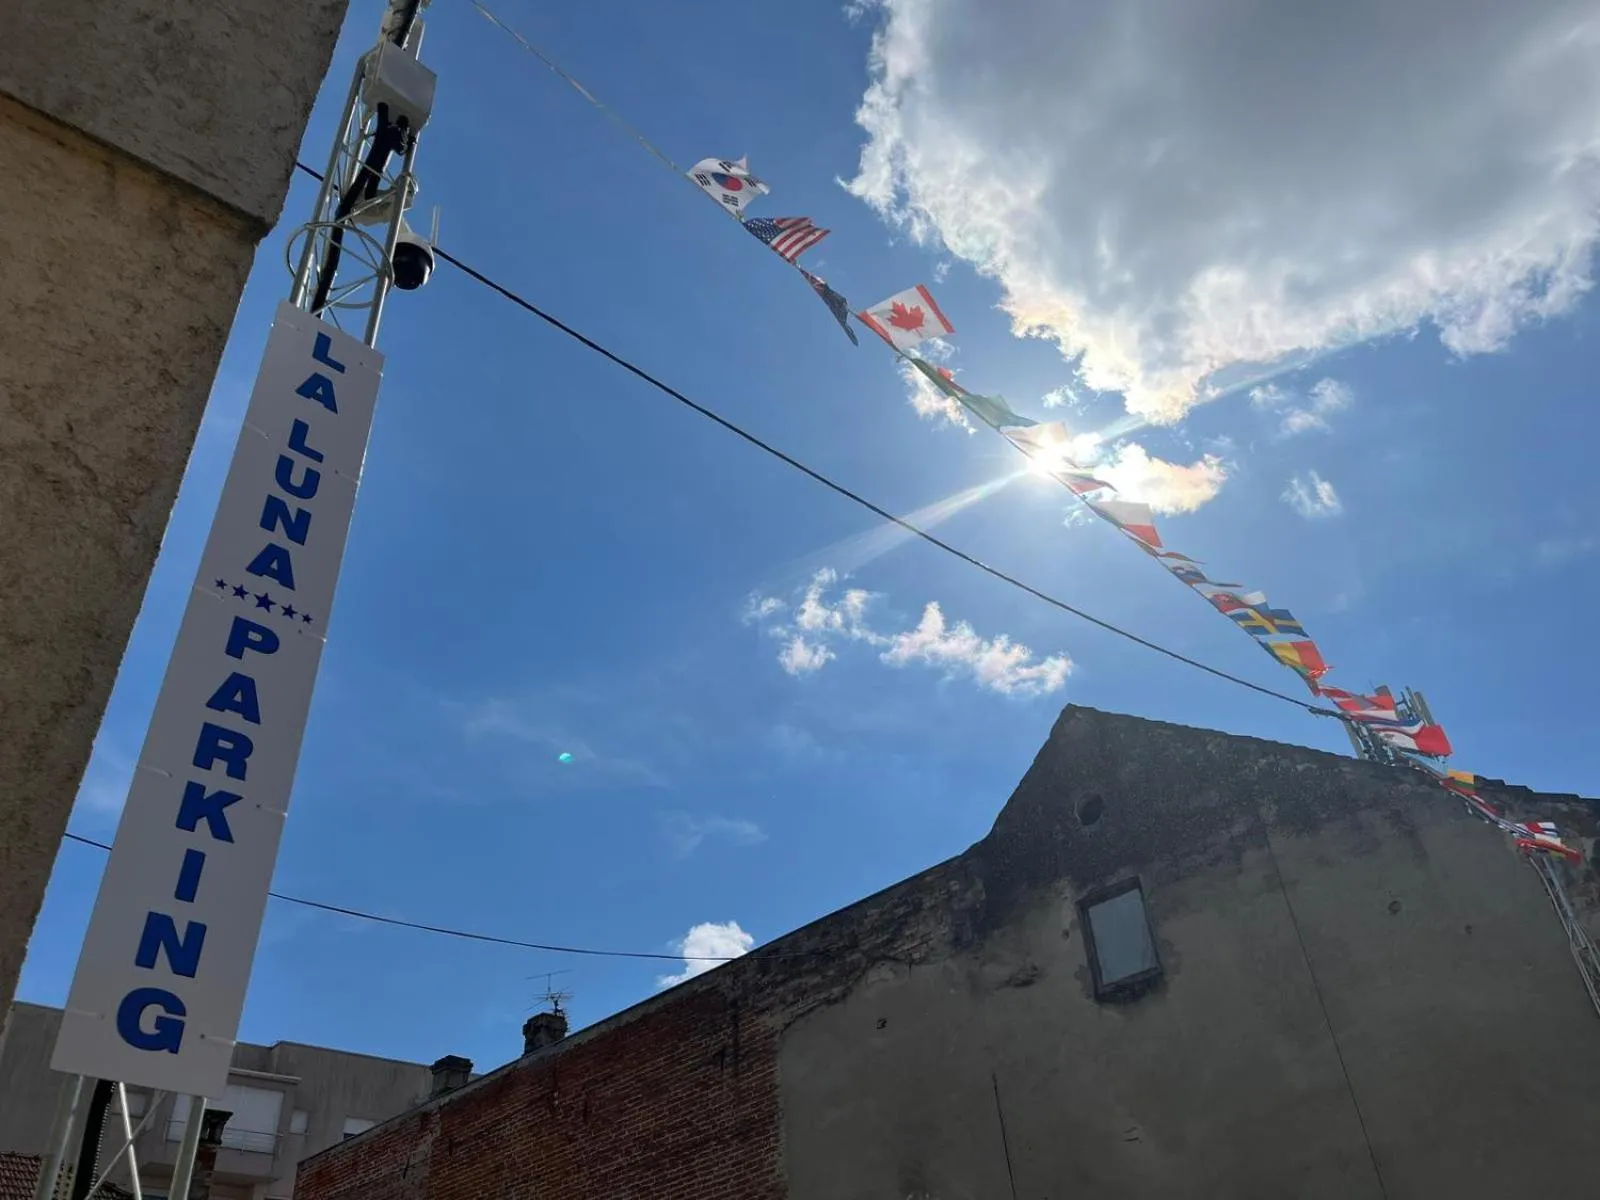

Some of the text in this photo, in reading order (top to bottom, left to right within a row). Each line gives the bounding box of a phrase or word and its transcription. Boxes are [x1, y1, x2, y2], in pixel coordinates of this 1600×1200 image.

[246, 331, 346, 592] LA LUNA
[116, 614, 281, 1055] PARKING
